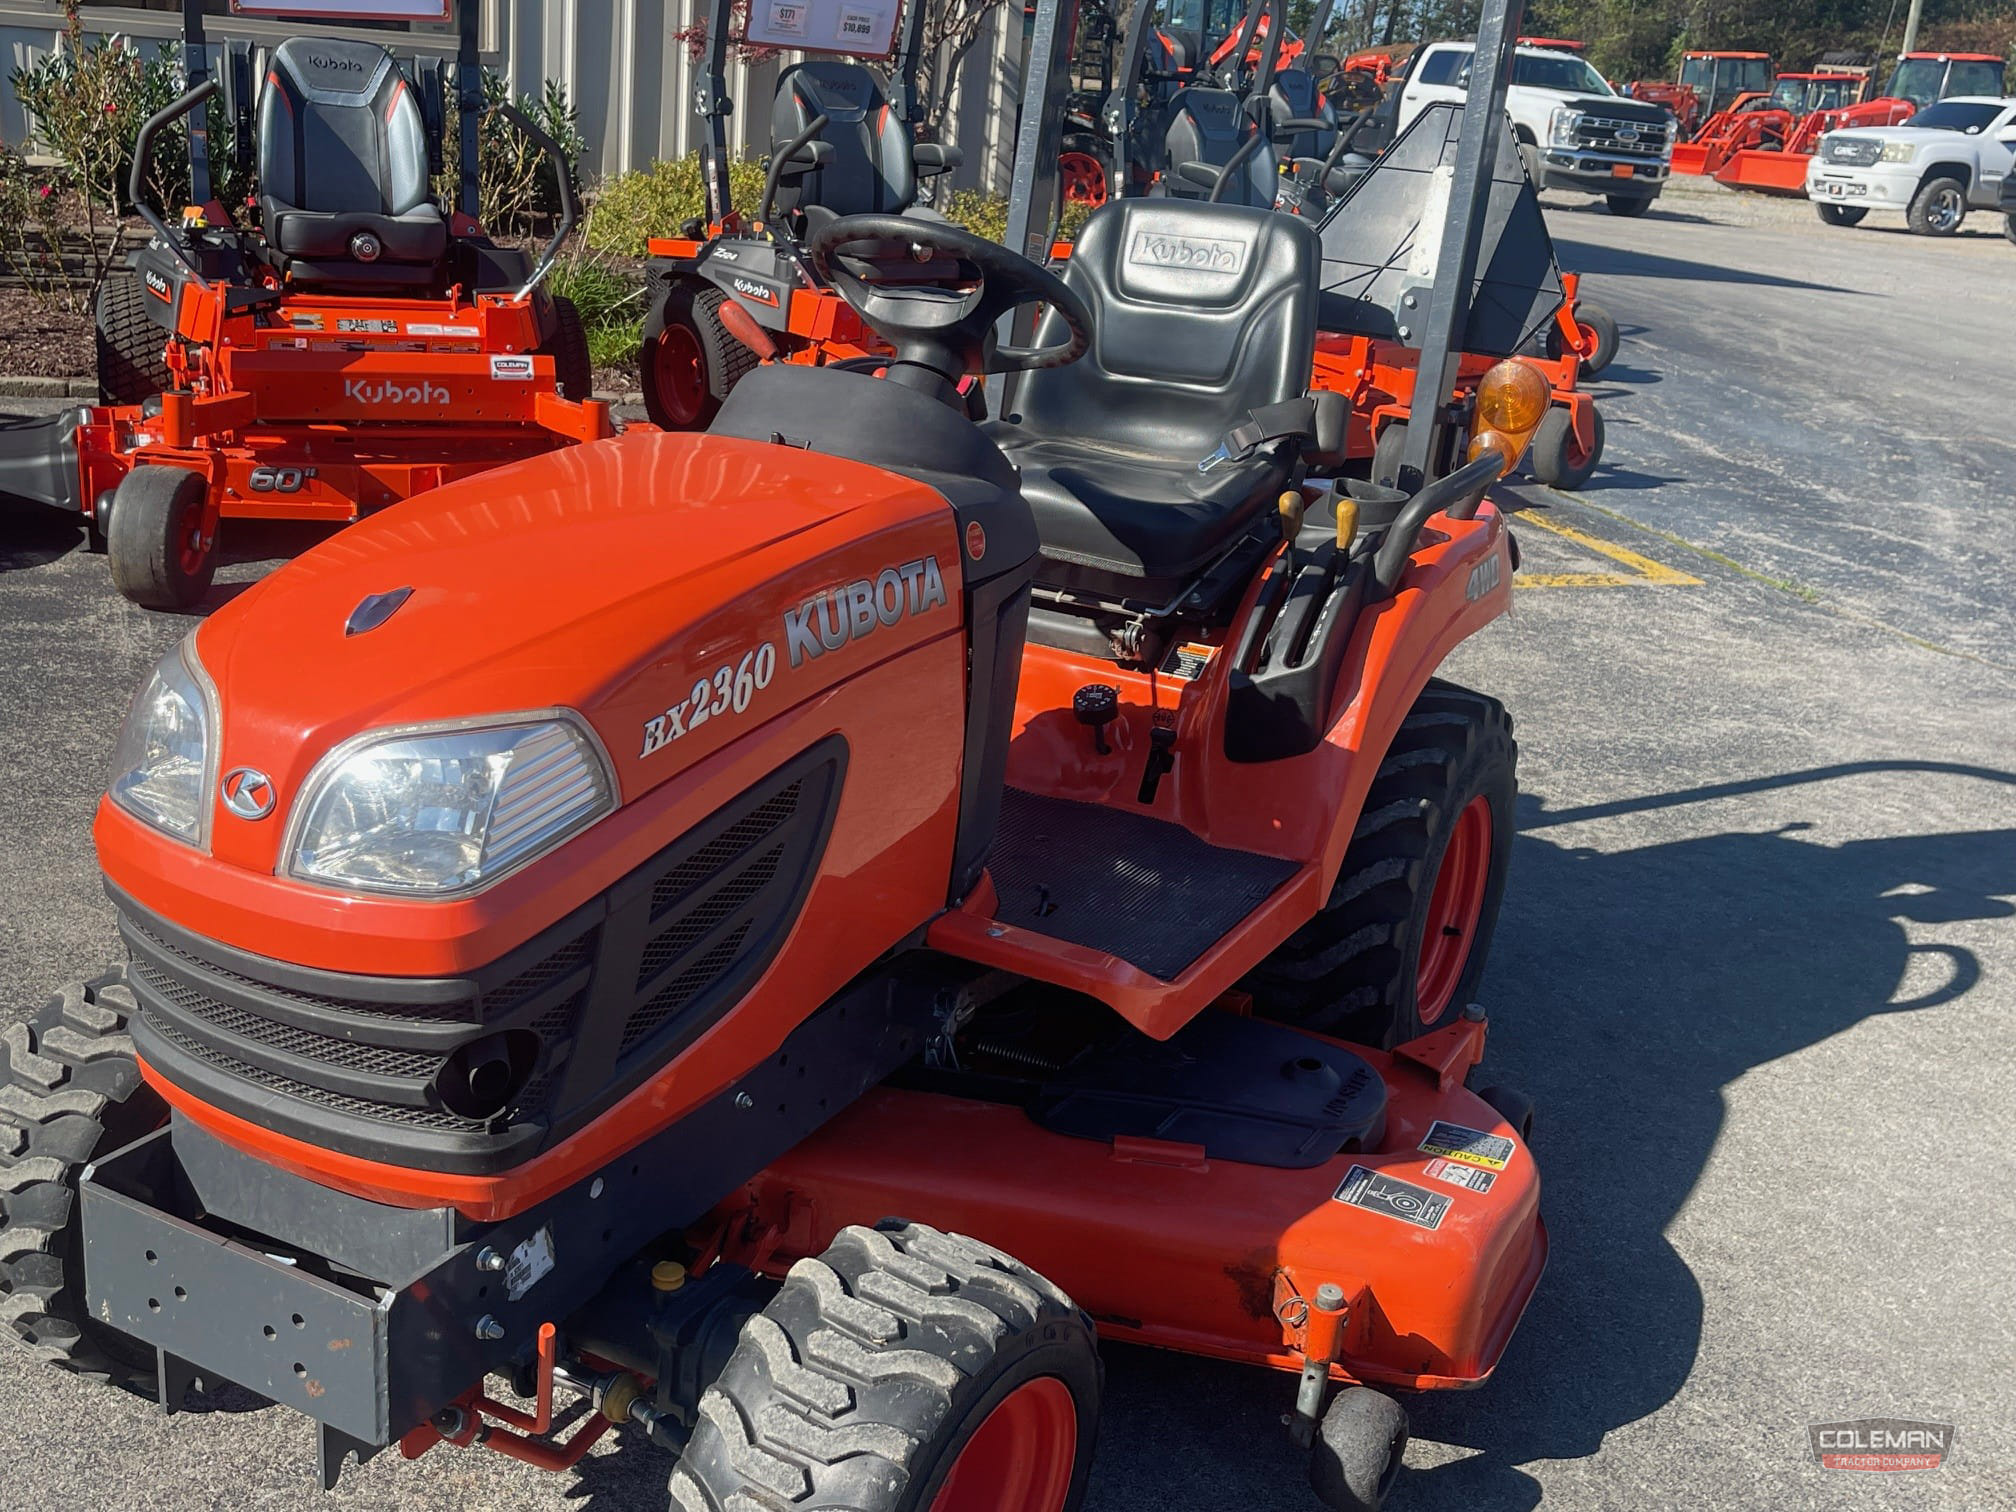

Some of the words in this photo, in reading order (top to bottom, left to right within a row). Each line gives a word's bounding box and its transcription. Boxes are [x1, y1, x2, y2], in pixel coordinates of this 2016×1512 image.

[779, 7, 796, 20] $171
[843, 22, 871, 34] $10,899
[309, 55, 363, 72] Kubota
[1142, 235, 1237, 270] Kubota
[145, 269, 167, 294] Kubota
[734, 278, 770, 299] Kubota
[344, 379, 450, 404] Kubota
[249, 466, 319, 493] 60"
[1465, 552, 1500, 602] 4WD
[783, 555, 948, 669] KUBOTA
[639, 641, 777, 760] BX2360
[1424, 1145, 1481, 1163] CAUTION
